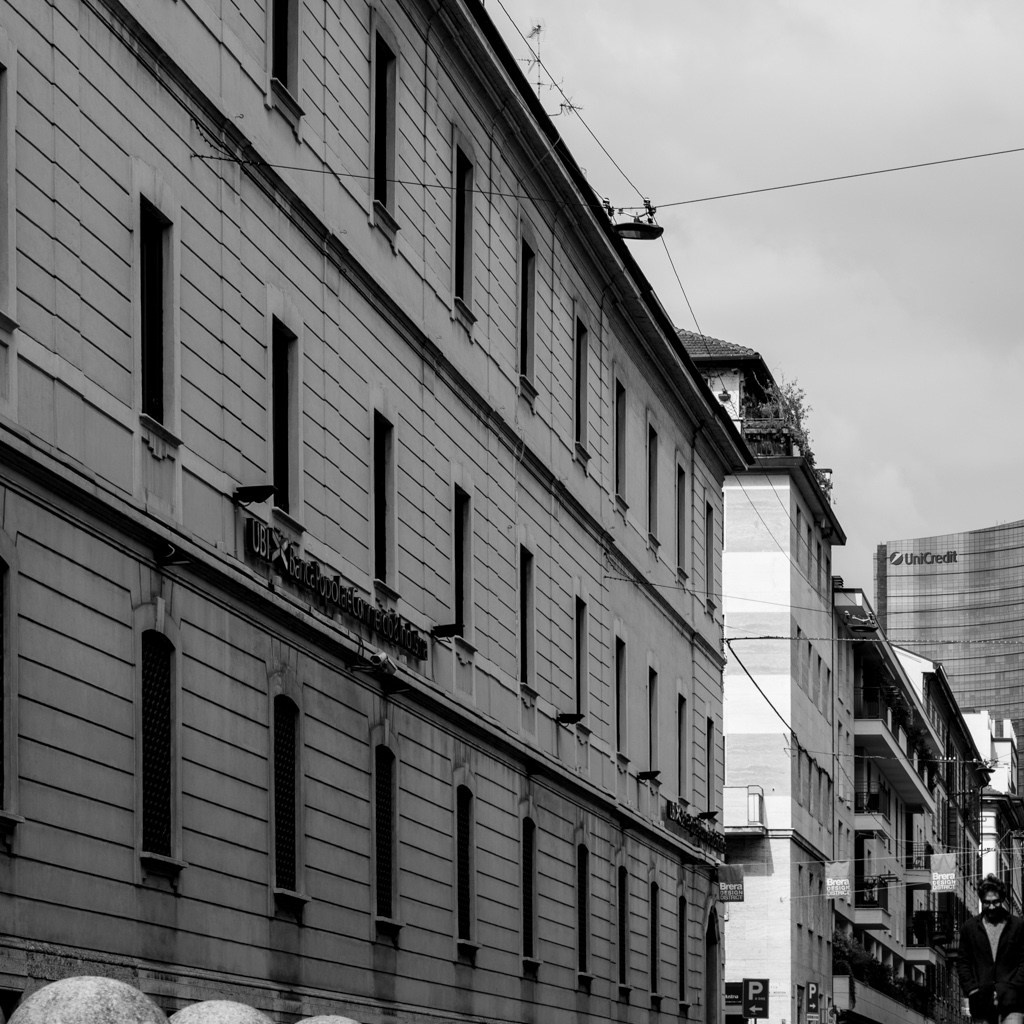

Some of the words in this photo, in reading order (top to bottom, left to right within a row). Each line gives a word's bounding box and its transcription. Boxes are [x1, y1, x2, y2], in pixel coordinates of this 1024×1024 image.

[252, 519, 270, 561] UBI
[904, 550, 958, 565] UniCredit
[826, 877, 850, 886] Brera
[932, 872, 956, 880] Brera
[719, 882, 743, 891] Brera
[748, 981, 763, 1000] P
[809, 983, 817, 999] P
